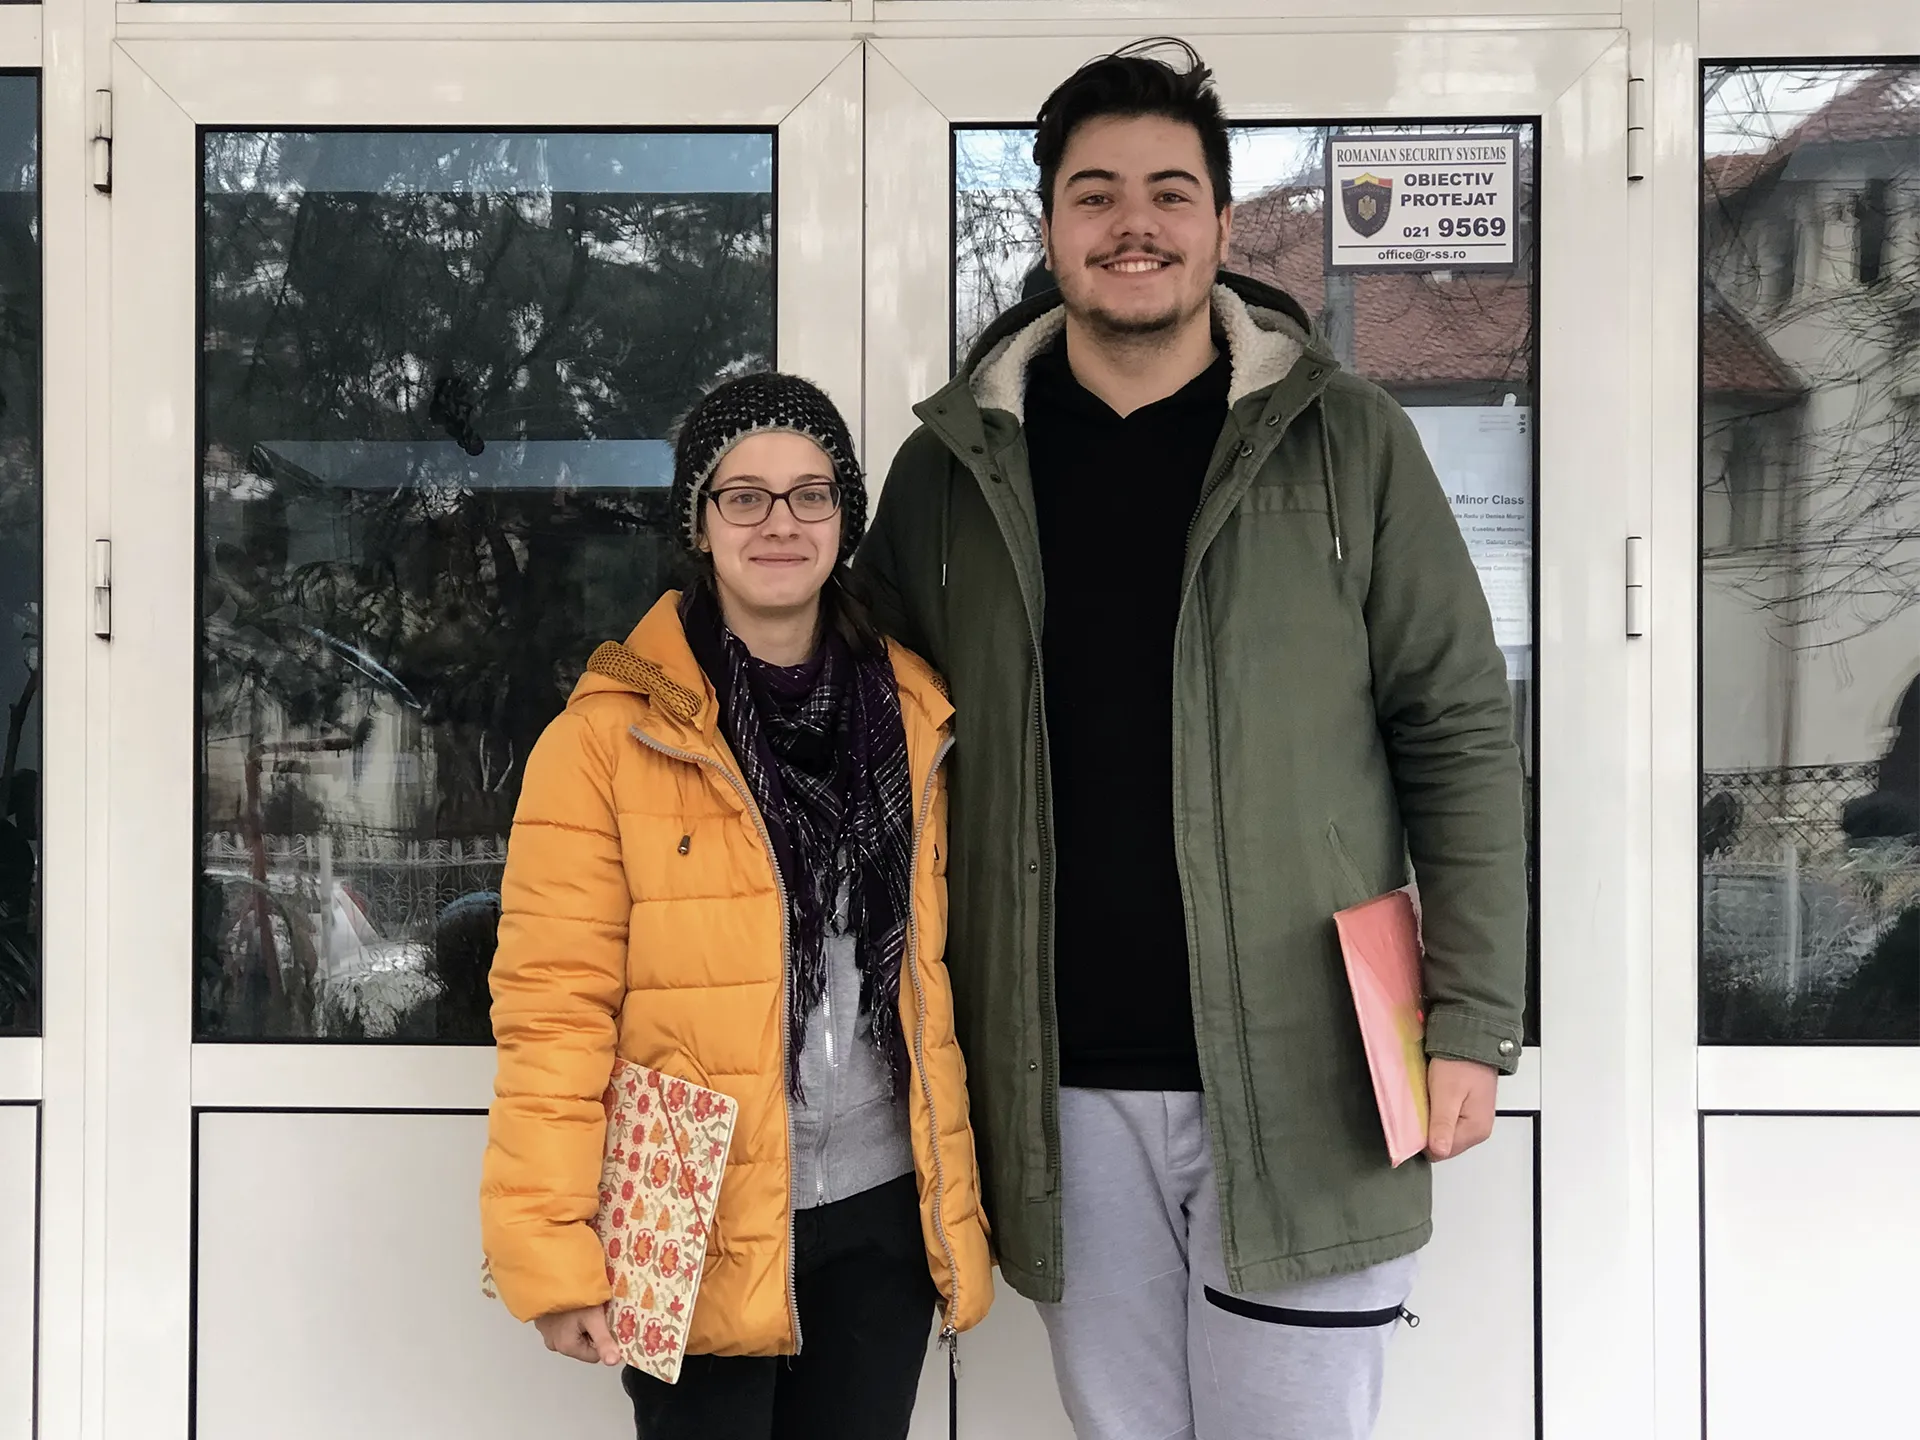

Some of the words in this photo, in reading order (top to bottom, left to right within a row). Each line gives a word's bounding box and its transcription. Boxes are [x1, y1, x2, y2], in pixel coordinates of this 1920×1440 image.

[1337, 148, 1397, 162] ROMANIAN
[1399, 147, 1454, 162] SECURITY
[1456, 146, 1506, 161] SYSTEMS
[1404, 172, 1494, 187] OBIECTIV
[1400, 192, 1497, 207] PROTEJAT
[1403, 226, 1429, 238] 021
[1438, 217, 1506, 237] 9569
[1378, 249, 1466, 262] office@r-ss.ro
[1456, 494, 1489, 505] Minor
[1492, 494, 1525, 505] Class
